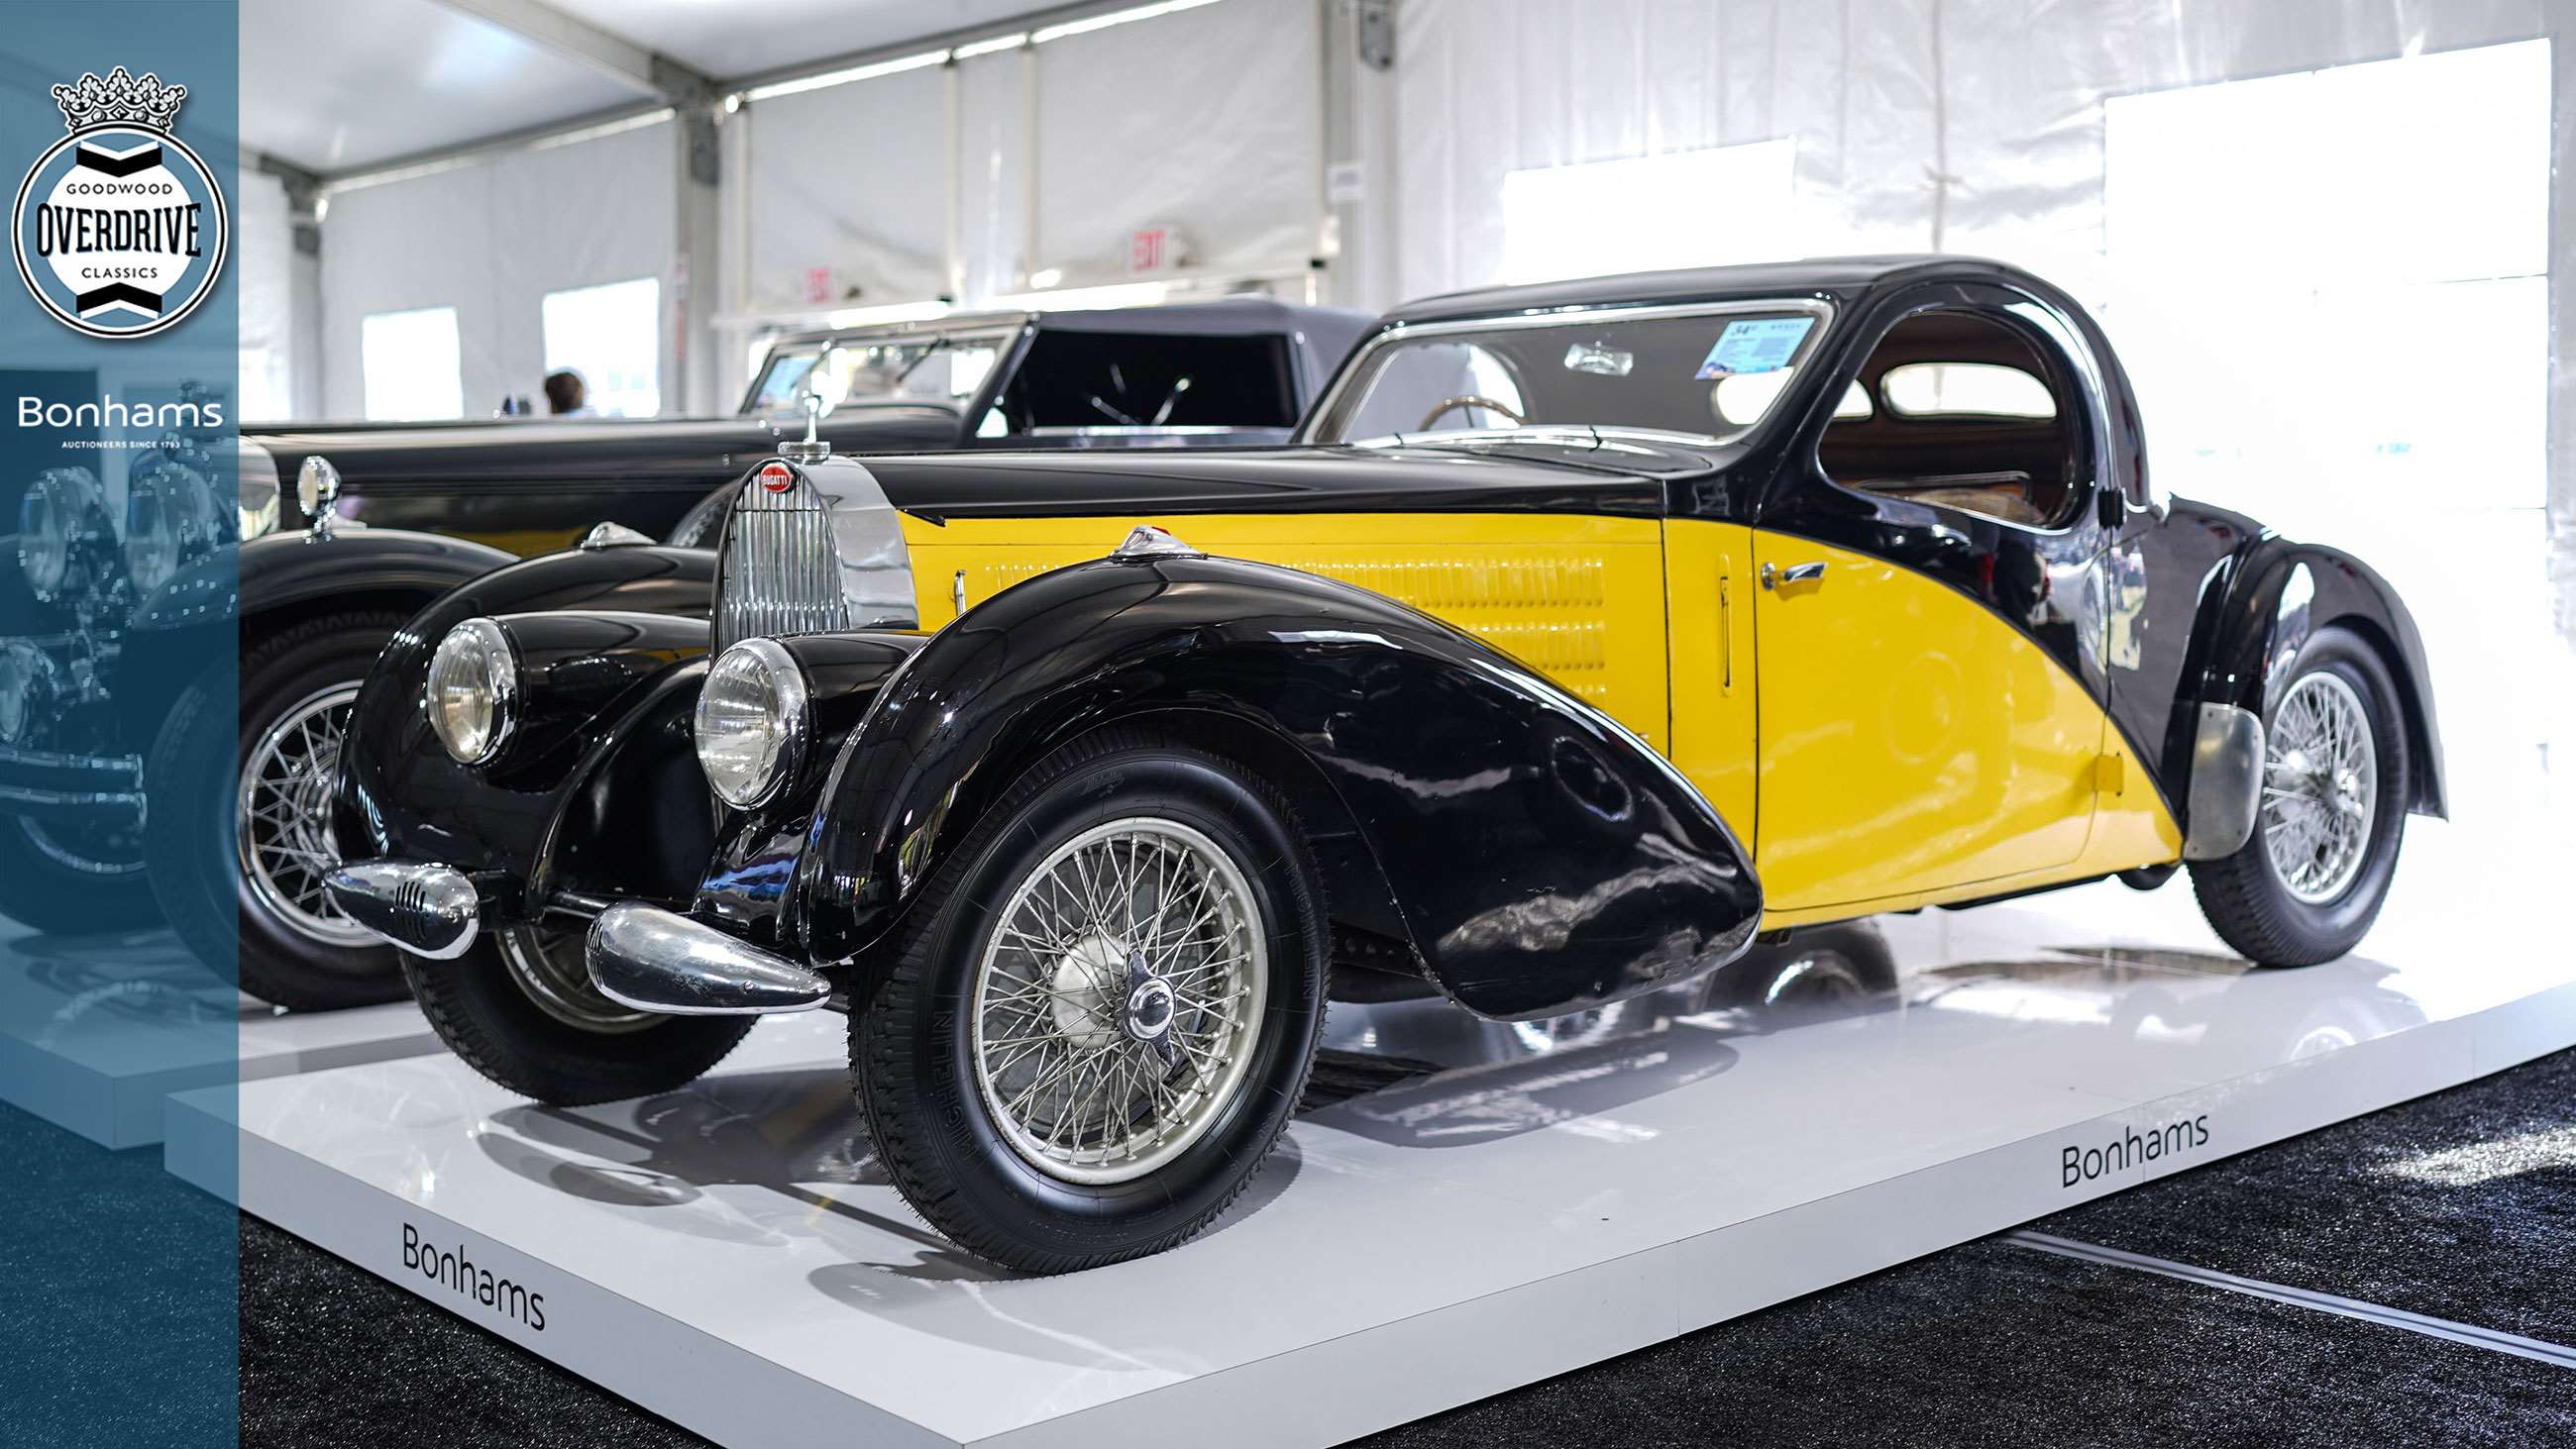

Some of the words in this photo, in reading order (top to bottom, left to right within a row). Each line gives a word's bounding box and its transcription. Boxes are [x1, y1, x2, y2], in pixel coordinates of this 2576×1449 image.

[762, 474, 788, 485] BUGATTI
[2062, 1115, 2209, 1189] Bonhams
[403, 1222, 546, 1331] Bonhams
